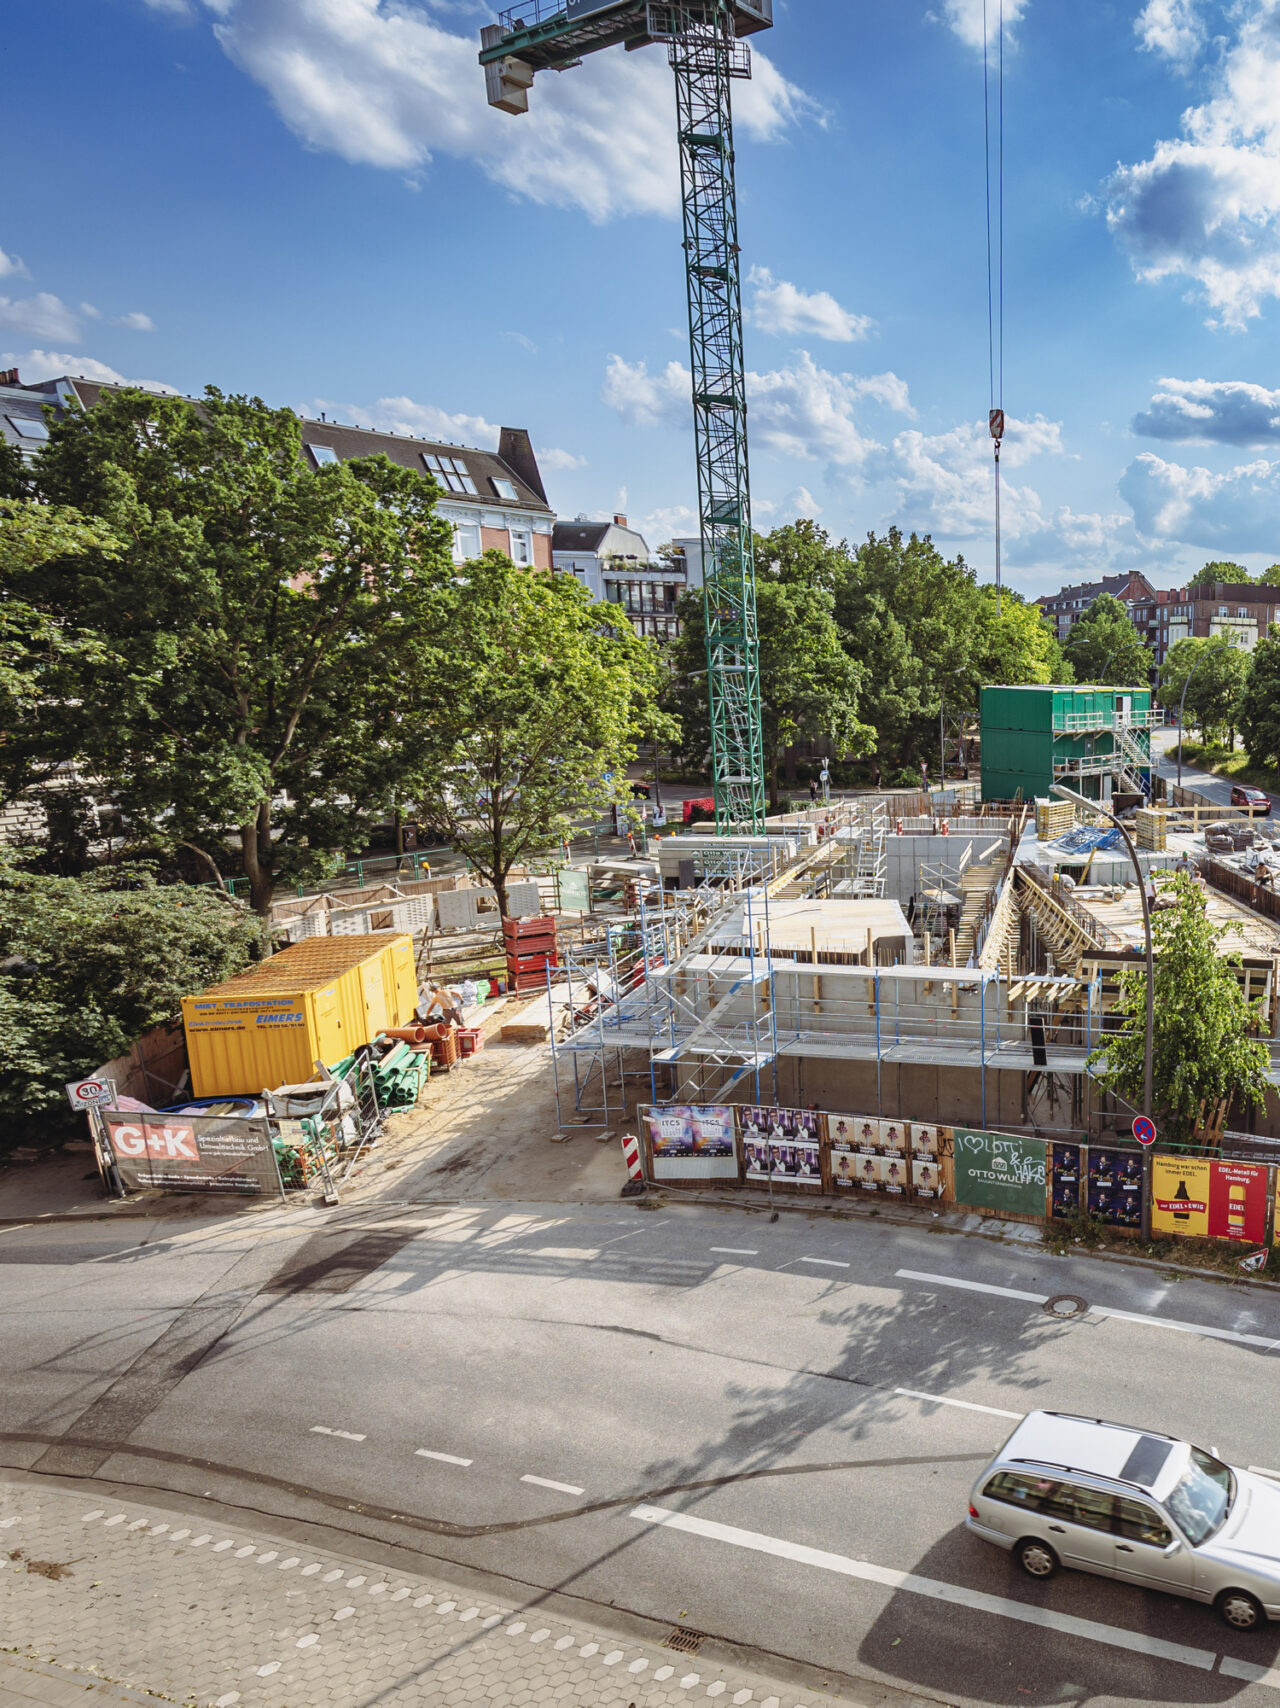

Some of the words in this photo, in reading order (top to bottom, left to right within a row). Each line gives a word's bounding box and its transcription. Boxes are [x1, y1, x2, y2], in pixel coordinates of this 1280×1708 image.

[255, 1013, 303, 1023] EIMERS
[82, 1086, 98, 1096] 30
[114, 1126, 196, 1157] G+K
[1156, 1161, 1180, 1170] Hamburg
[968, 1169, 996, 1179] OTTO
